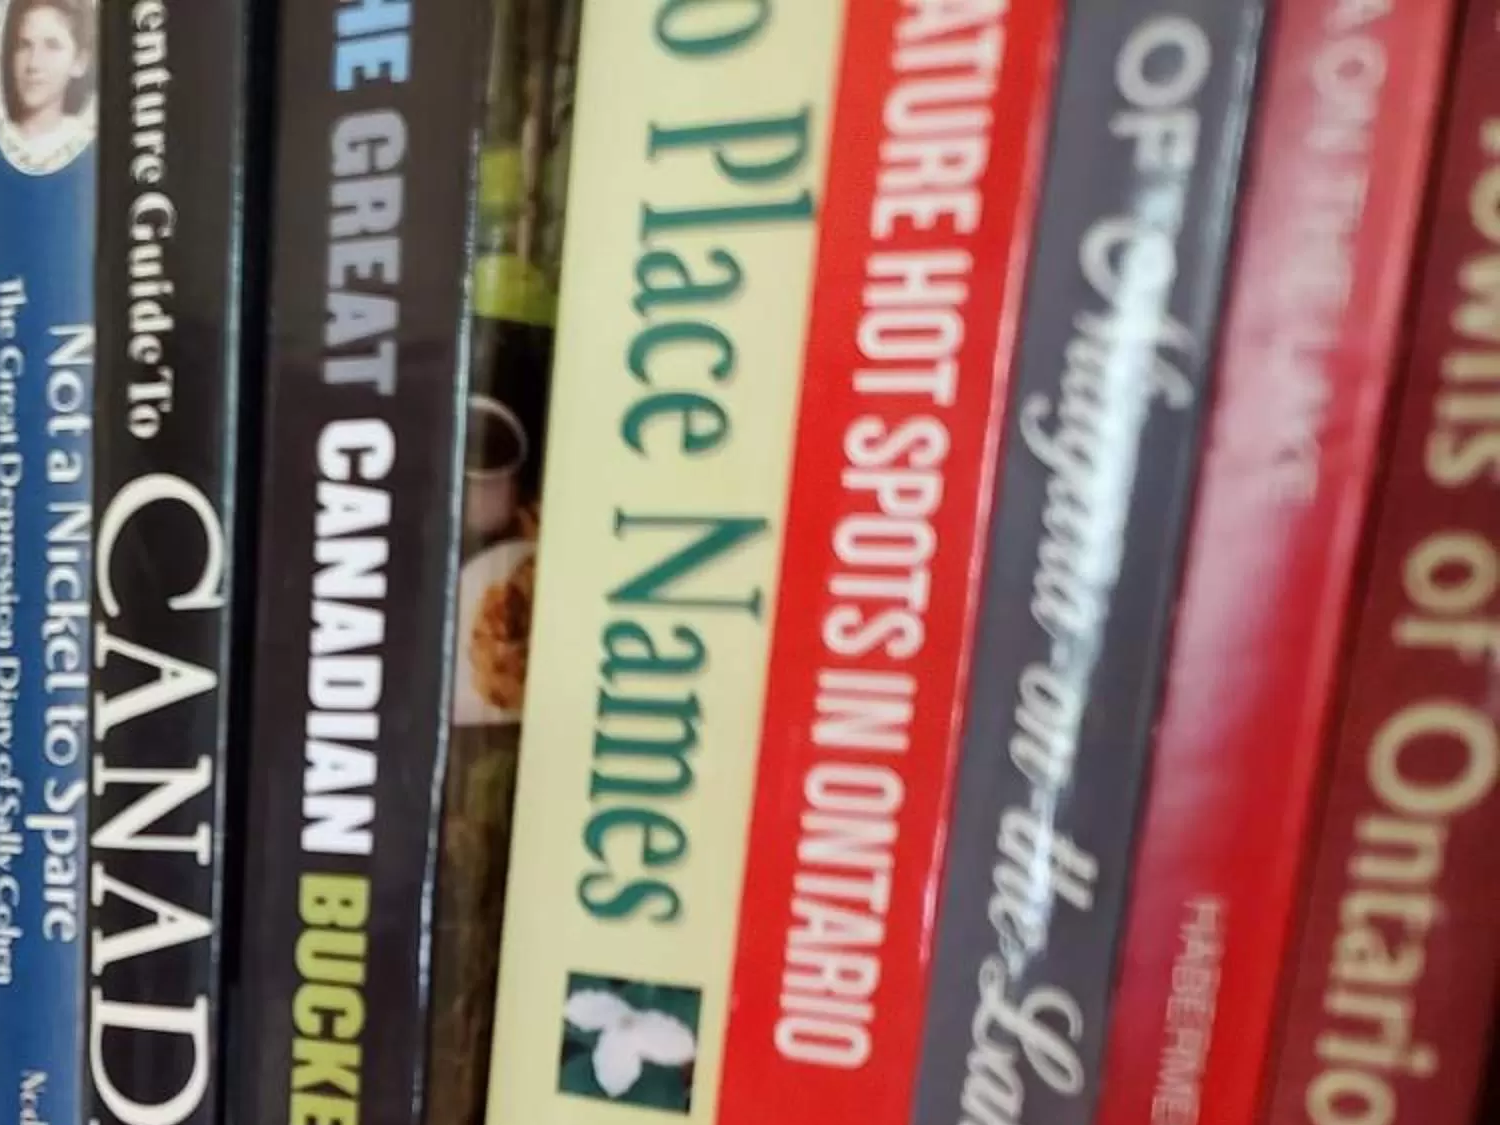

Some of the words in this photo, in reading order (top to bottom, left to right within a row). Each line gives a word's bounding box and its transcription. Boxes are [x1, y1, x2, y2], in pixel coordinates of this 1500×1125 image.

[130, 0, 172, 184] enture
[1107, 14, 1212, 174] OF
[127, 192, 177, 365] Guide
[324, 108, 407, 396] GREAT
[621, 102, 814, 457] Place
[851, 248, 974, 407] HOT
[46, 325, 95, 437] Not
[47, 449, 84, 483] a
[127, 368, 174, 440] To
[41, 501, 93, 694] Nickel
[821, 413, 951, 659] SPOTS
[301, 418, 396, 855] CANADIAN
[576, 506, 770, 926] Names
[811, 668, 917, 753] IN
[44, 705, 88, 766] to
[24, 778, 88, 943] Spare
[773, 761, 905, 1070] ONTARIO
